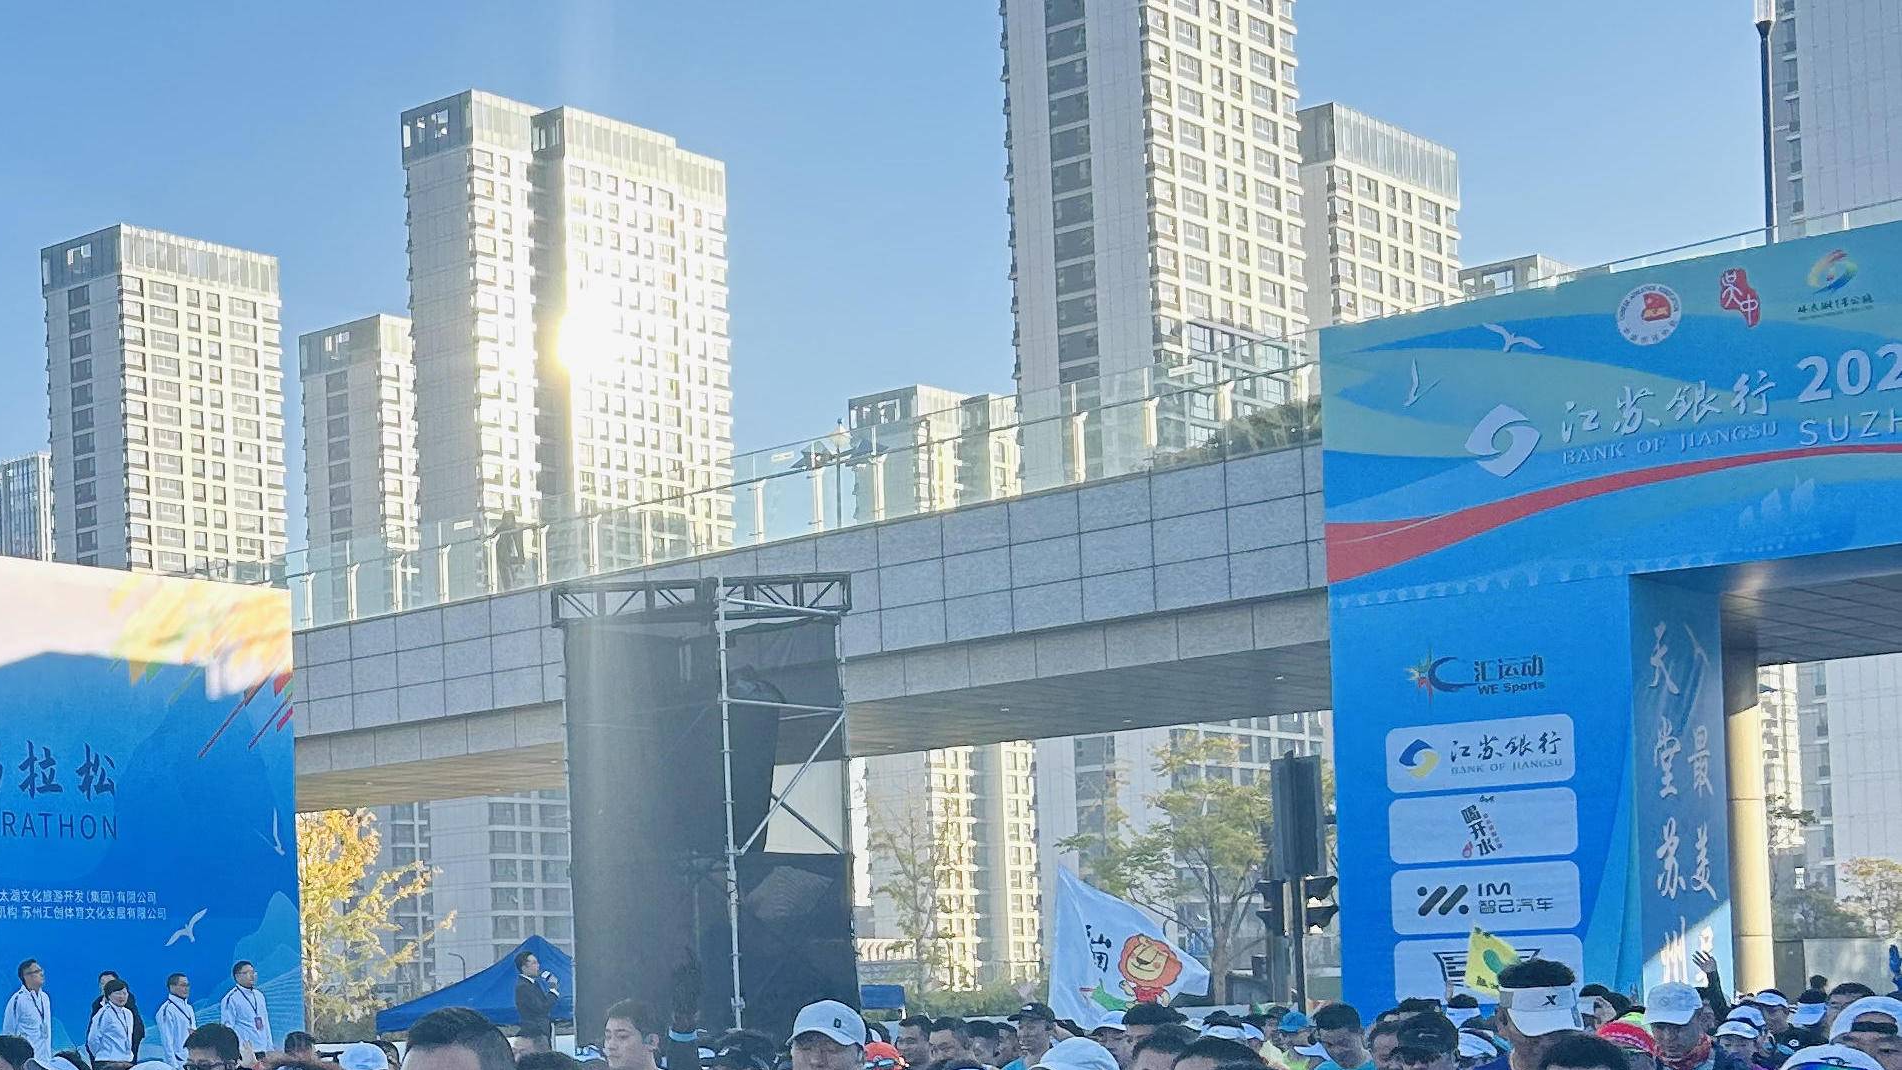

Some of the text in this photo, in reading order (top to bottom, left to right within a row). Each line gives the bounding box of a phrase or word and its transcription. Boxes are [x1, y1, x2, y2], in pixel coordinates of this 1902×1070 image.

[1560, 369, 1777, 443] 江苏银行
[1561, 421, 1779, 465] BANK OF JIANGSU
[1478, 680, 1546, 695] WE Sports
[1450, 730, 1562, 762] 江苏银行
[1450, 759, 1563, 775] BANK OF JIANGSU
[1478, 882, 1512, 896] IM
[1478, 897, 1554, 915] 智己汽车
